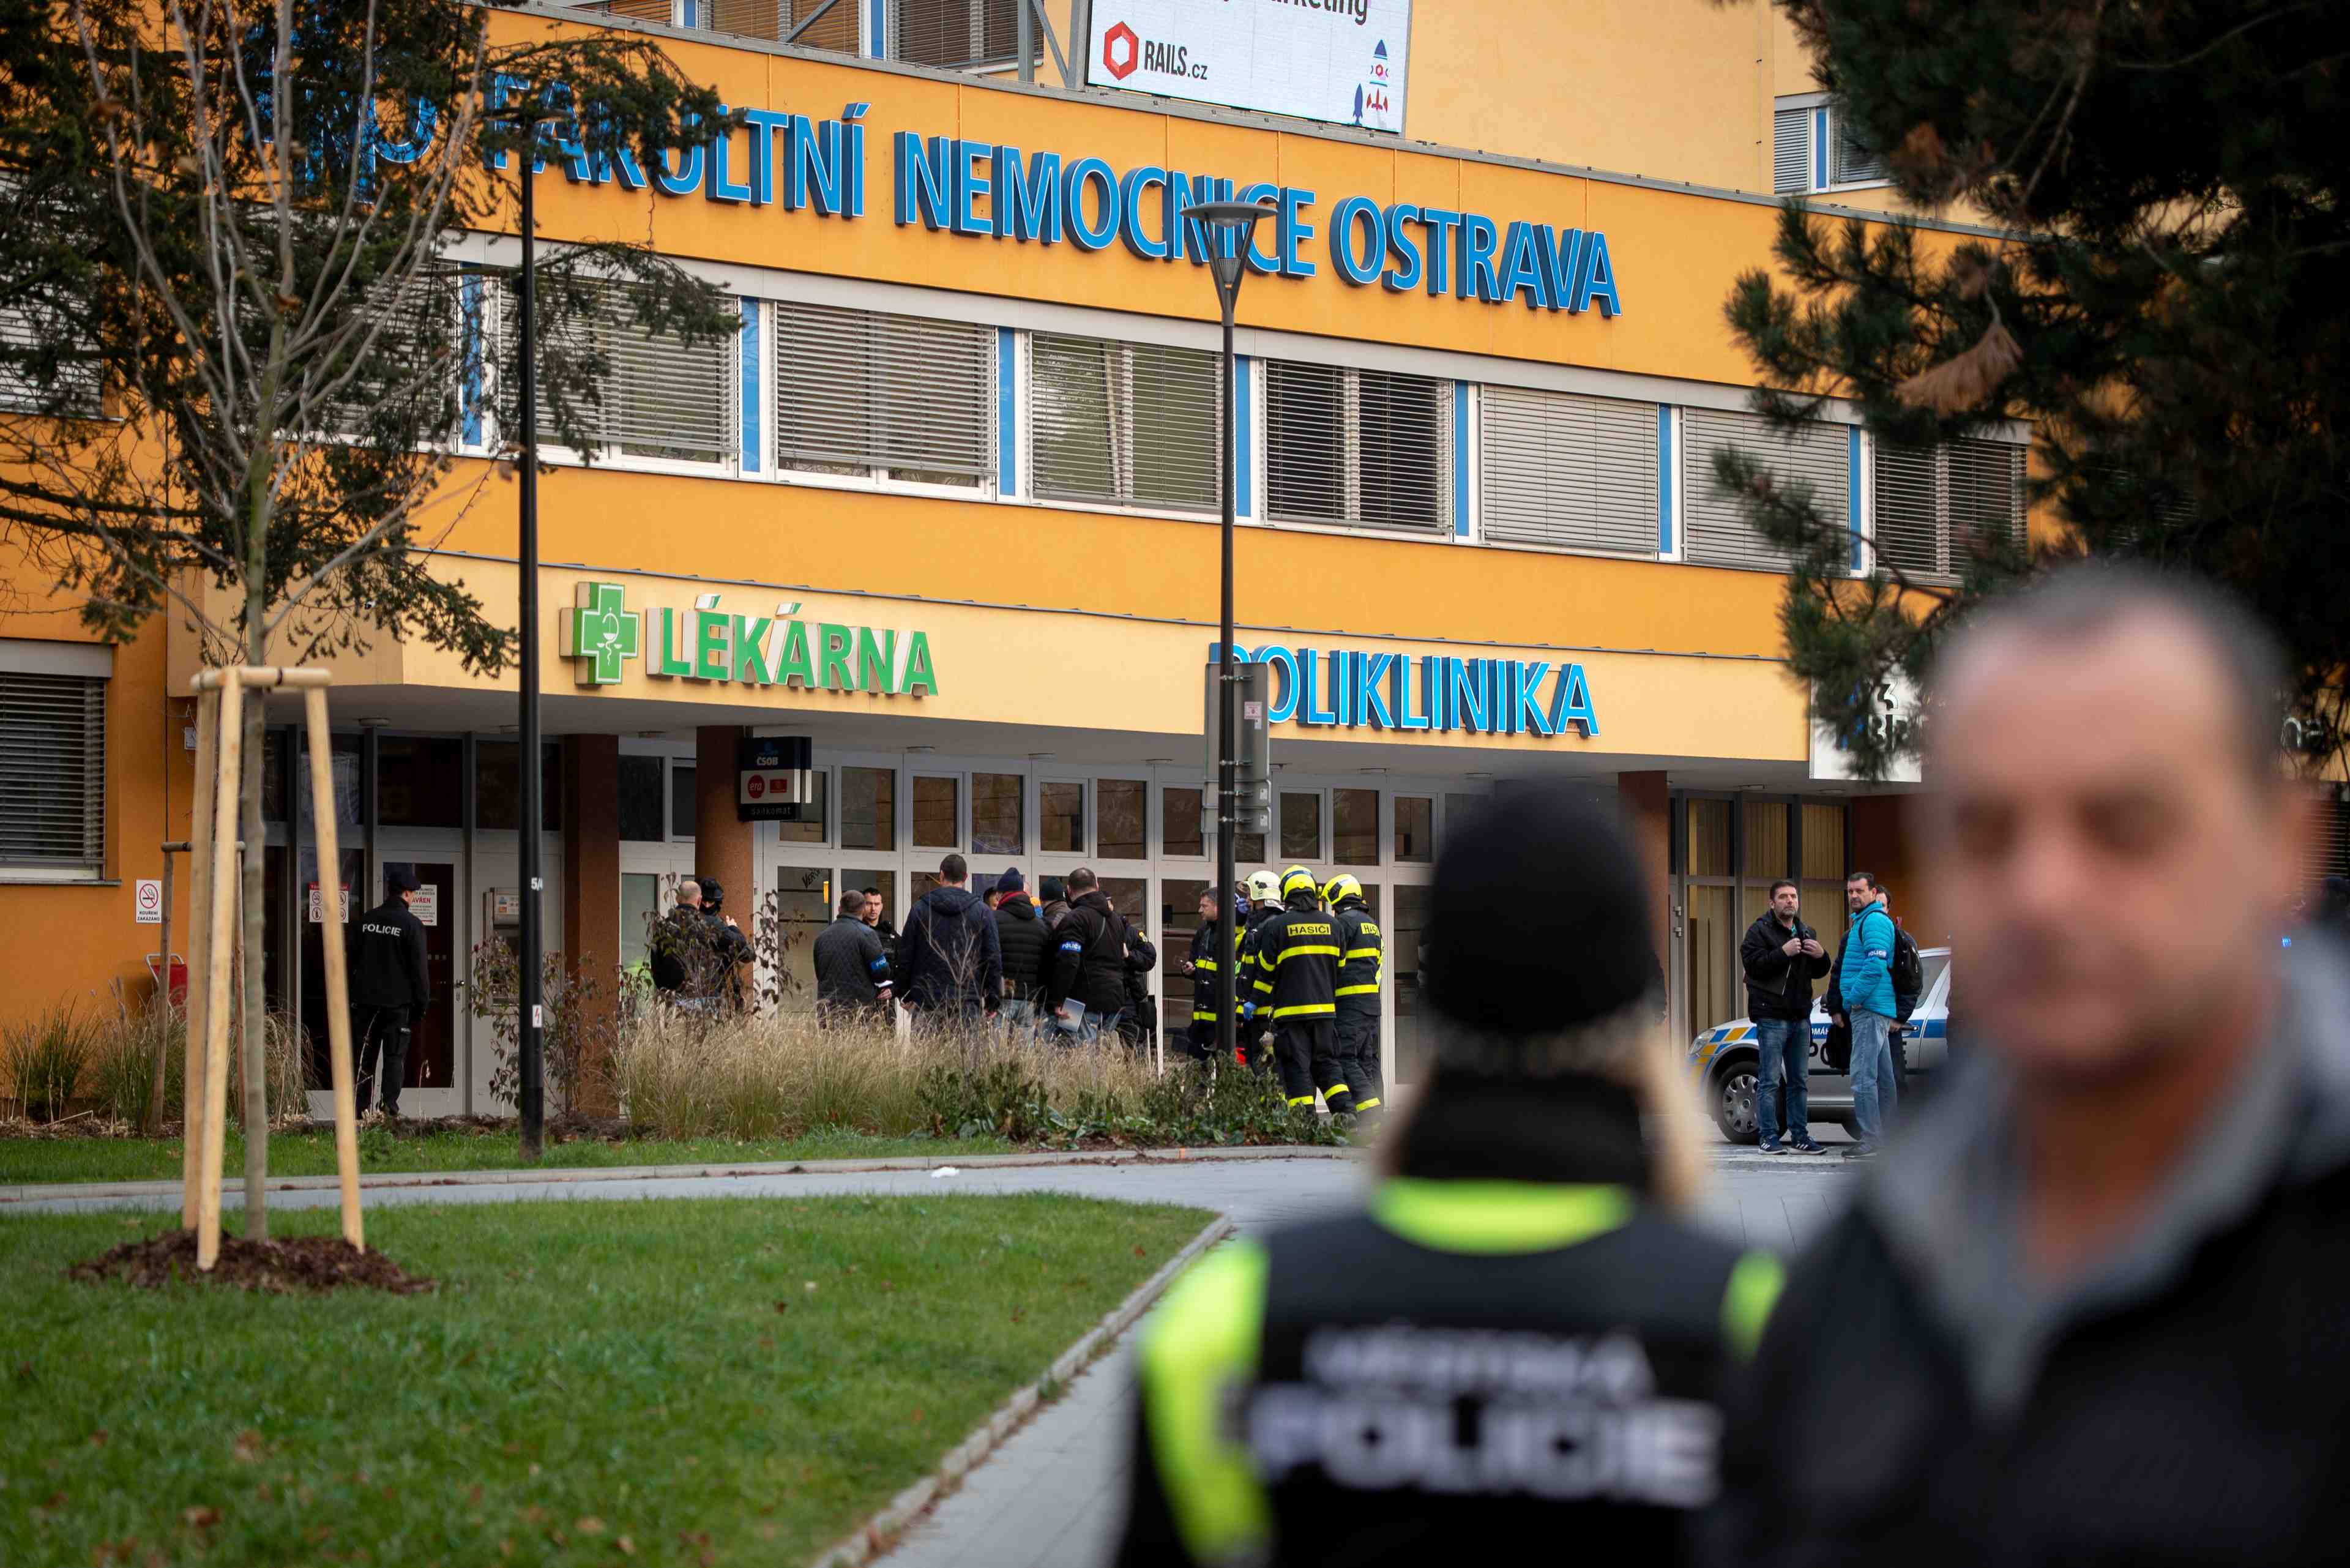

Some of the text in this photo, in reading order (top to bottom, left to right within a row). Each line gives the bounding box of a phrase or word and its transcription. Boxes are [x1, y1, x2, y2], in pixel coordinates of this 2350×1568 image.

[1144, 40, 1208, 81] RAILS.cz
[894, 130, 1316, 278] NEMOCNICE
[1329, 195, 1622, 318] OSTRAVA
[646, 593, 938, 696] LÉKÁRNA
[1209, 643, 1601, 737] OLIKLINIKA
[750, 782, 763, 791] era
[362, 923, 402, 936] POLICIE
